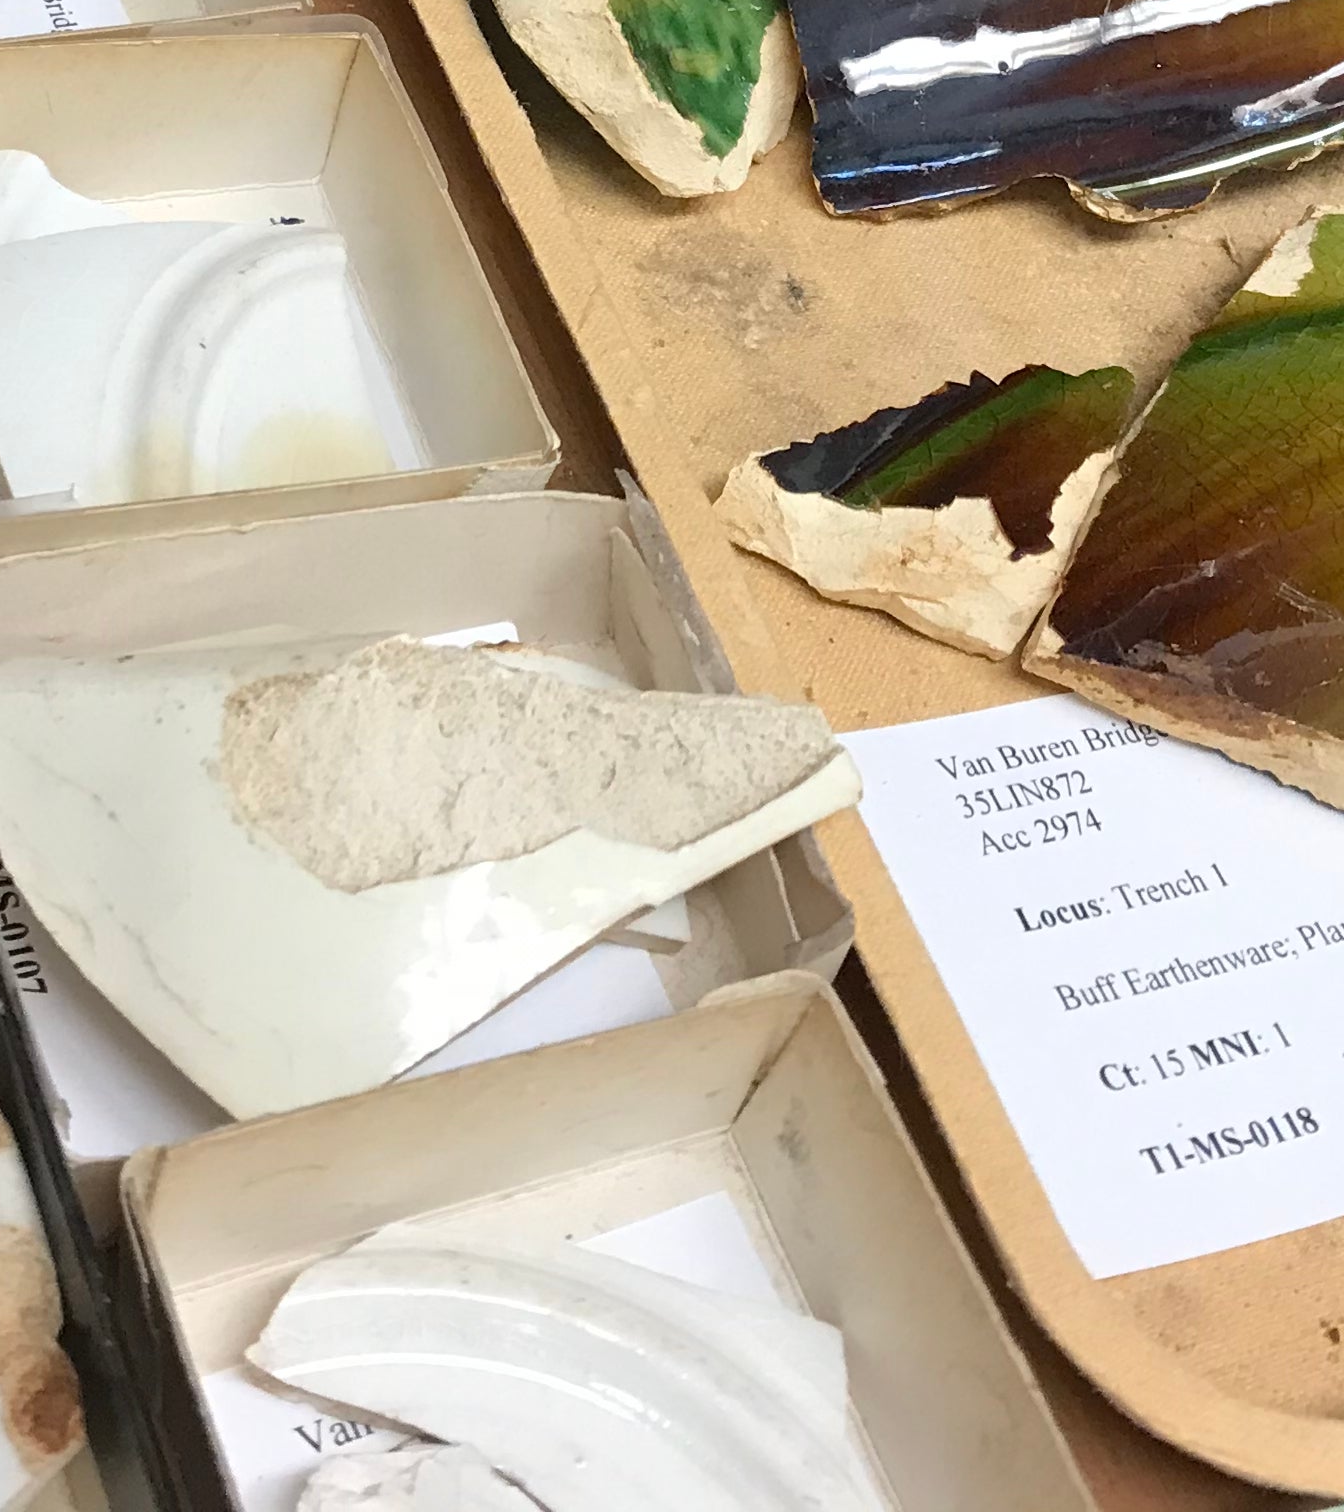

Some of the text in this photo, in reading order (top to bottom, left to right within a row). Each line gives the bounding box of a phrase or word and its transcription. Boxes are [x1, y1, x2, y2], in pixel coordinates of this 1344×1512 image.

[934, 719, 1169, 781] Van Buren Bridge
[954, 769, 1094, 820] 35LIN872
[981, 807, 1103, 857] Acc 2974
[1013, 862, 1230, 933] Locus: Trench 1
[1053, 972, 1122, 1012] Buff
[1121, 935, 1300, 997] Earthenware;
[1098, 1021, 1292, 1093] Ct: 15 MNI: 1
[1138, 1105, 1321, 1176] T1-MS-0118
